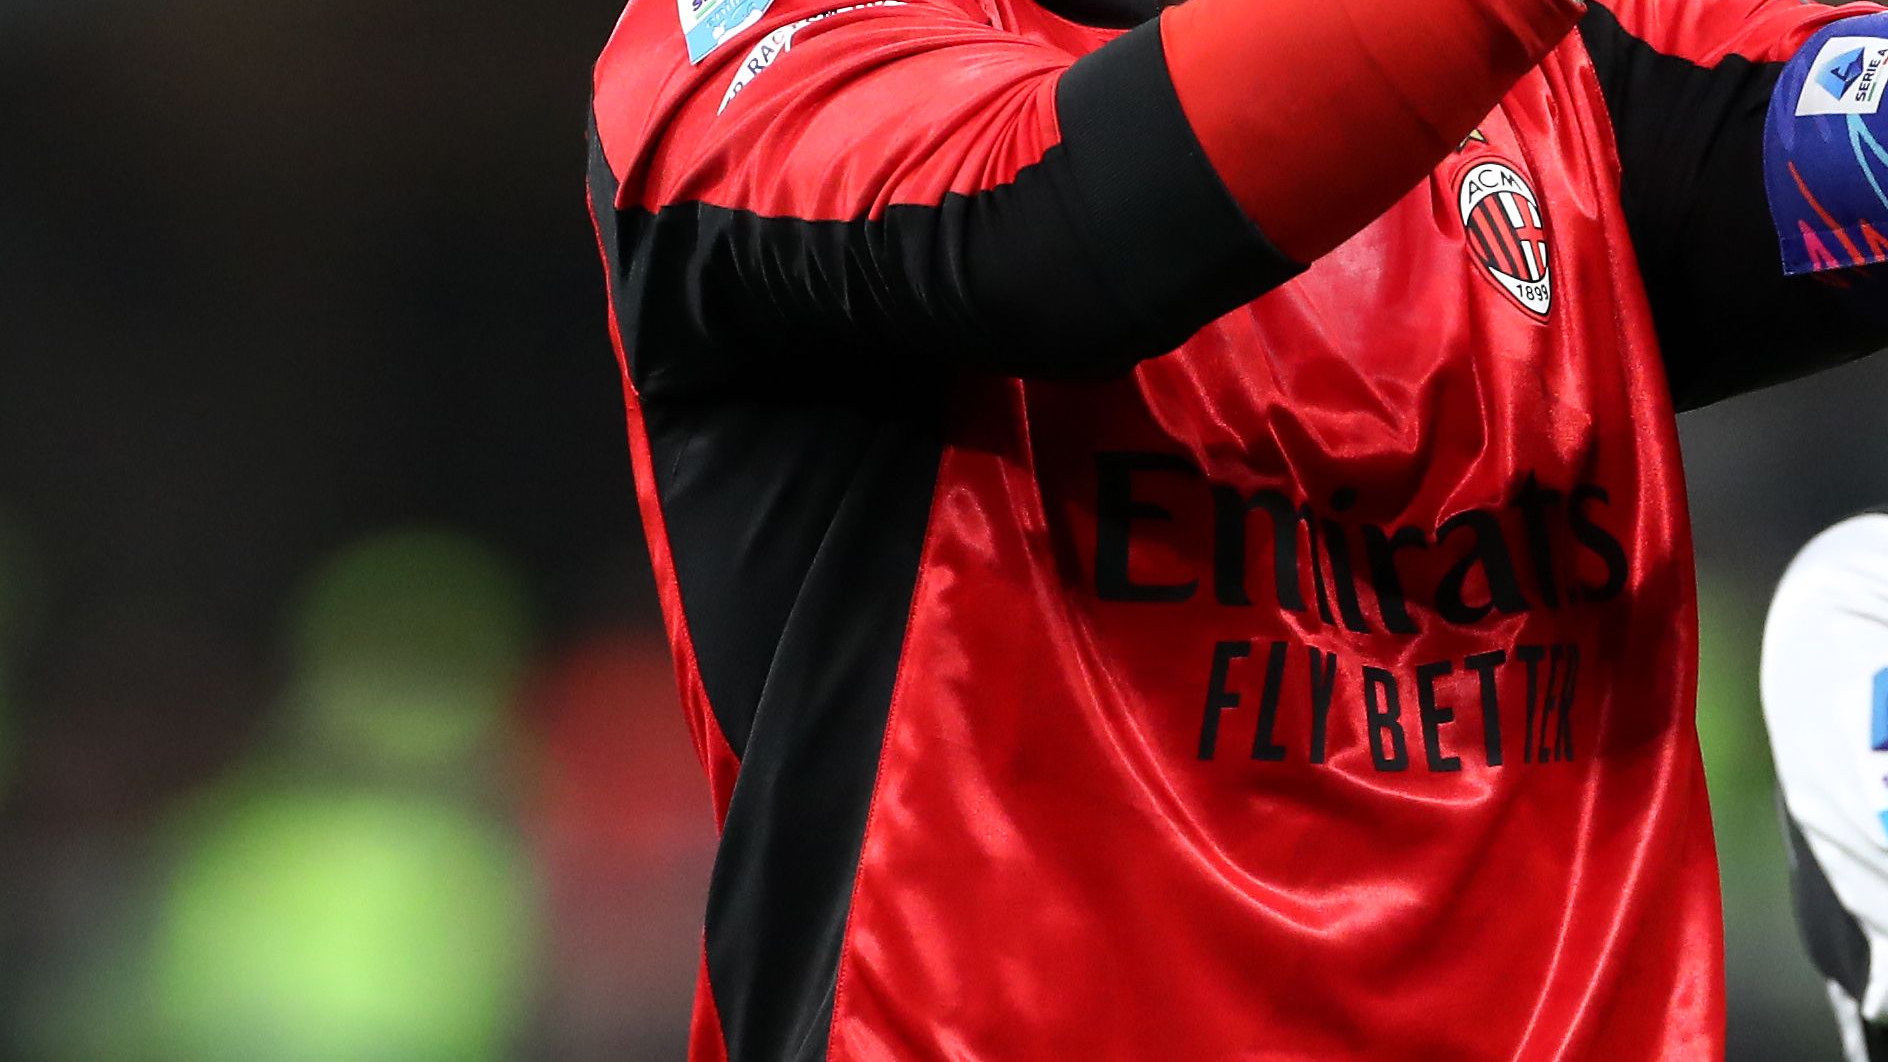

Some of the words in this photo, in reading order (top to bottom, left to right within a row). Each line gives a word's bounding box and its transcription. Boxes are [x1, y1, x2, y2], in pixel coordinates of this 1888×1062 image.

[1855, 58, 1881, 102] SERIE
[1468, 169, 1524, 204] ACM
[1516, 284, 1549, 301] 1899
[1094, 454, 1628, 635] Emirats
[1197, 641, 1337, 765] FLY
[1363, 644, 1580, 772] BETTER
